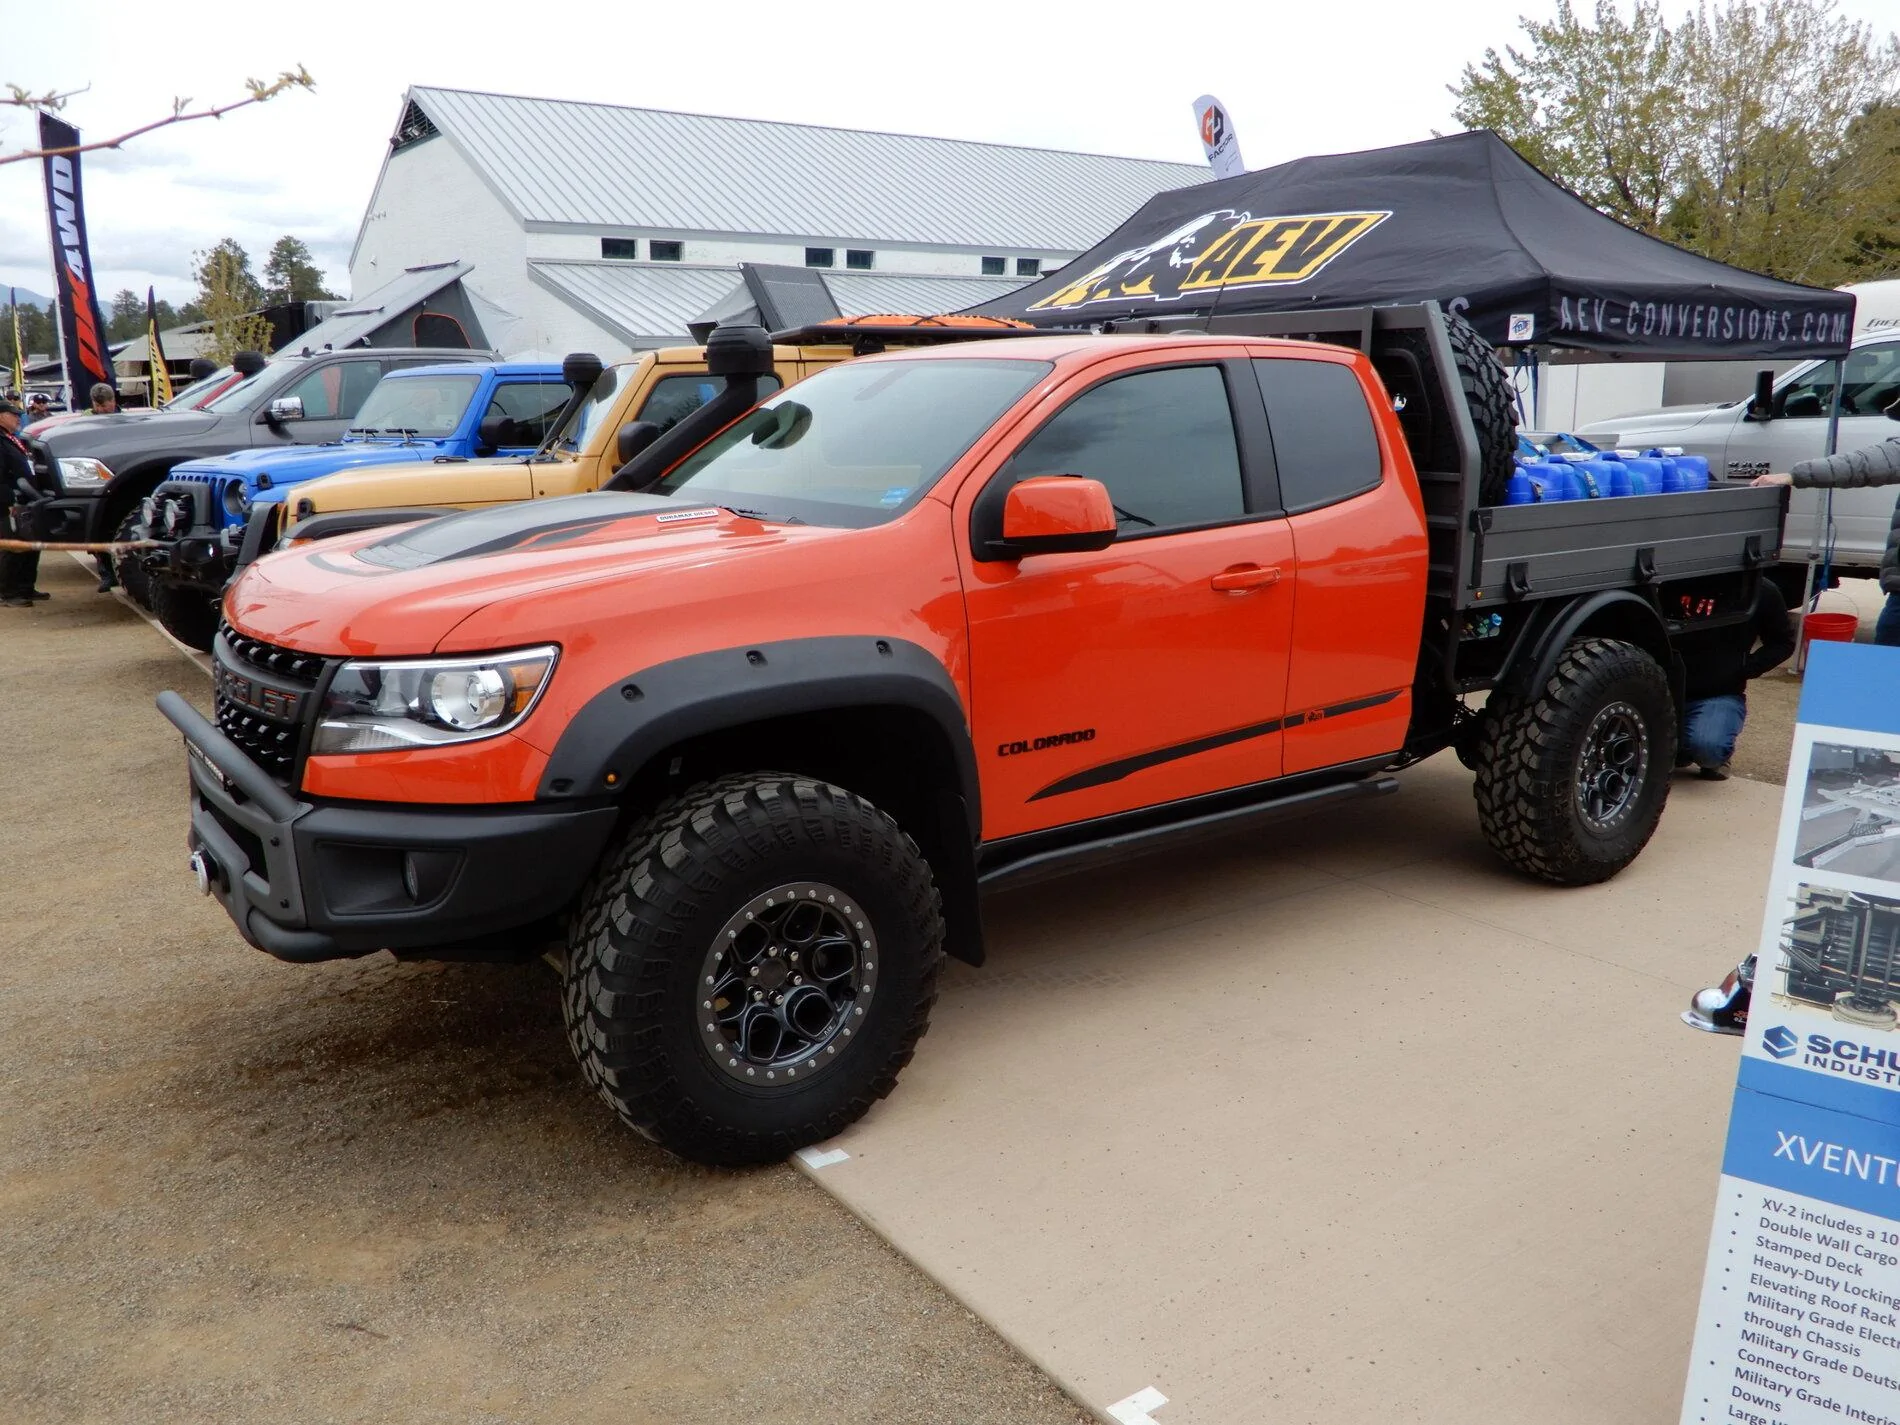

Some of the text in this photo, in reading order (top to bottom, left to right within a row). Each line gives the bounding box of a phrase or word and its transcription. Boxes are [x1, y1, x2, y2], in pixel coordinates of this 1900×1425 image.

[1208, 133, 1233, 162] FACTOR
[1186, 217, 1350, 284] AEV
[1559, 296, 1848, 344] AEV-CONVERSIONS.COM
[659, 513, 693, 521] DURAMAX
[997, 727, 1096, 757] COLORADO
[1804, 1053, 1900, 1087] INDUST
[1773, 1130, 1900, 1188] XVENT
[1759, 1217, 1898, 1266] Double Wall Cargo
[1761, 1197, 1899, 1246] XV-2 includes a 10
[1756, 1235, 1863, 1277] Stamped Deck
[1750, 1272, 1897, 1328] Elevating Roof Rack
[1753, 1254, 1900, 1311] Heavy-Duty Locking
[1744, 1310, 1861, 1357] through Chassis
[1747, 1291, 1805, 1321] Military
[1808, 1311, 1855, 1335] Grade
[1737, 1348, 1821, 1385] Connectors
[1740, 1329, 1900, 1391] Military Grade Deuts
[1731, 1385, 1782, 1412] Downs
[1734, 1366, 1793, 1398] Military
[1796, 1388, 1842, 1412] Grade
[1728, 1404, 1767, 1425] Large
